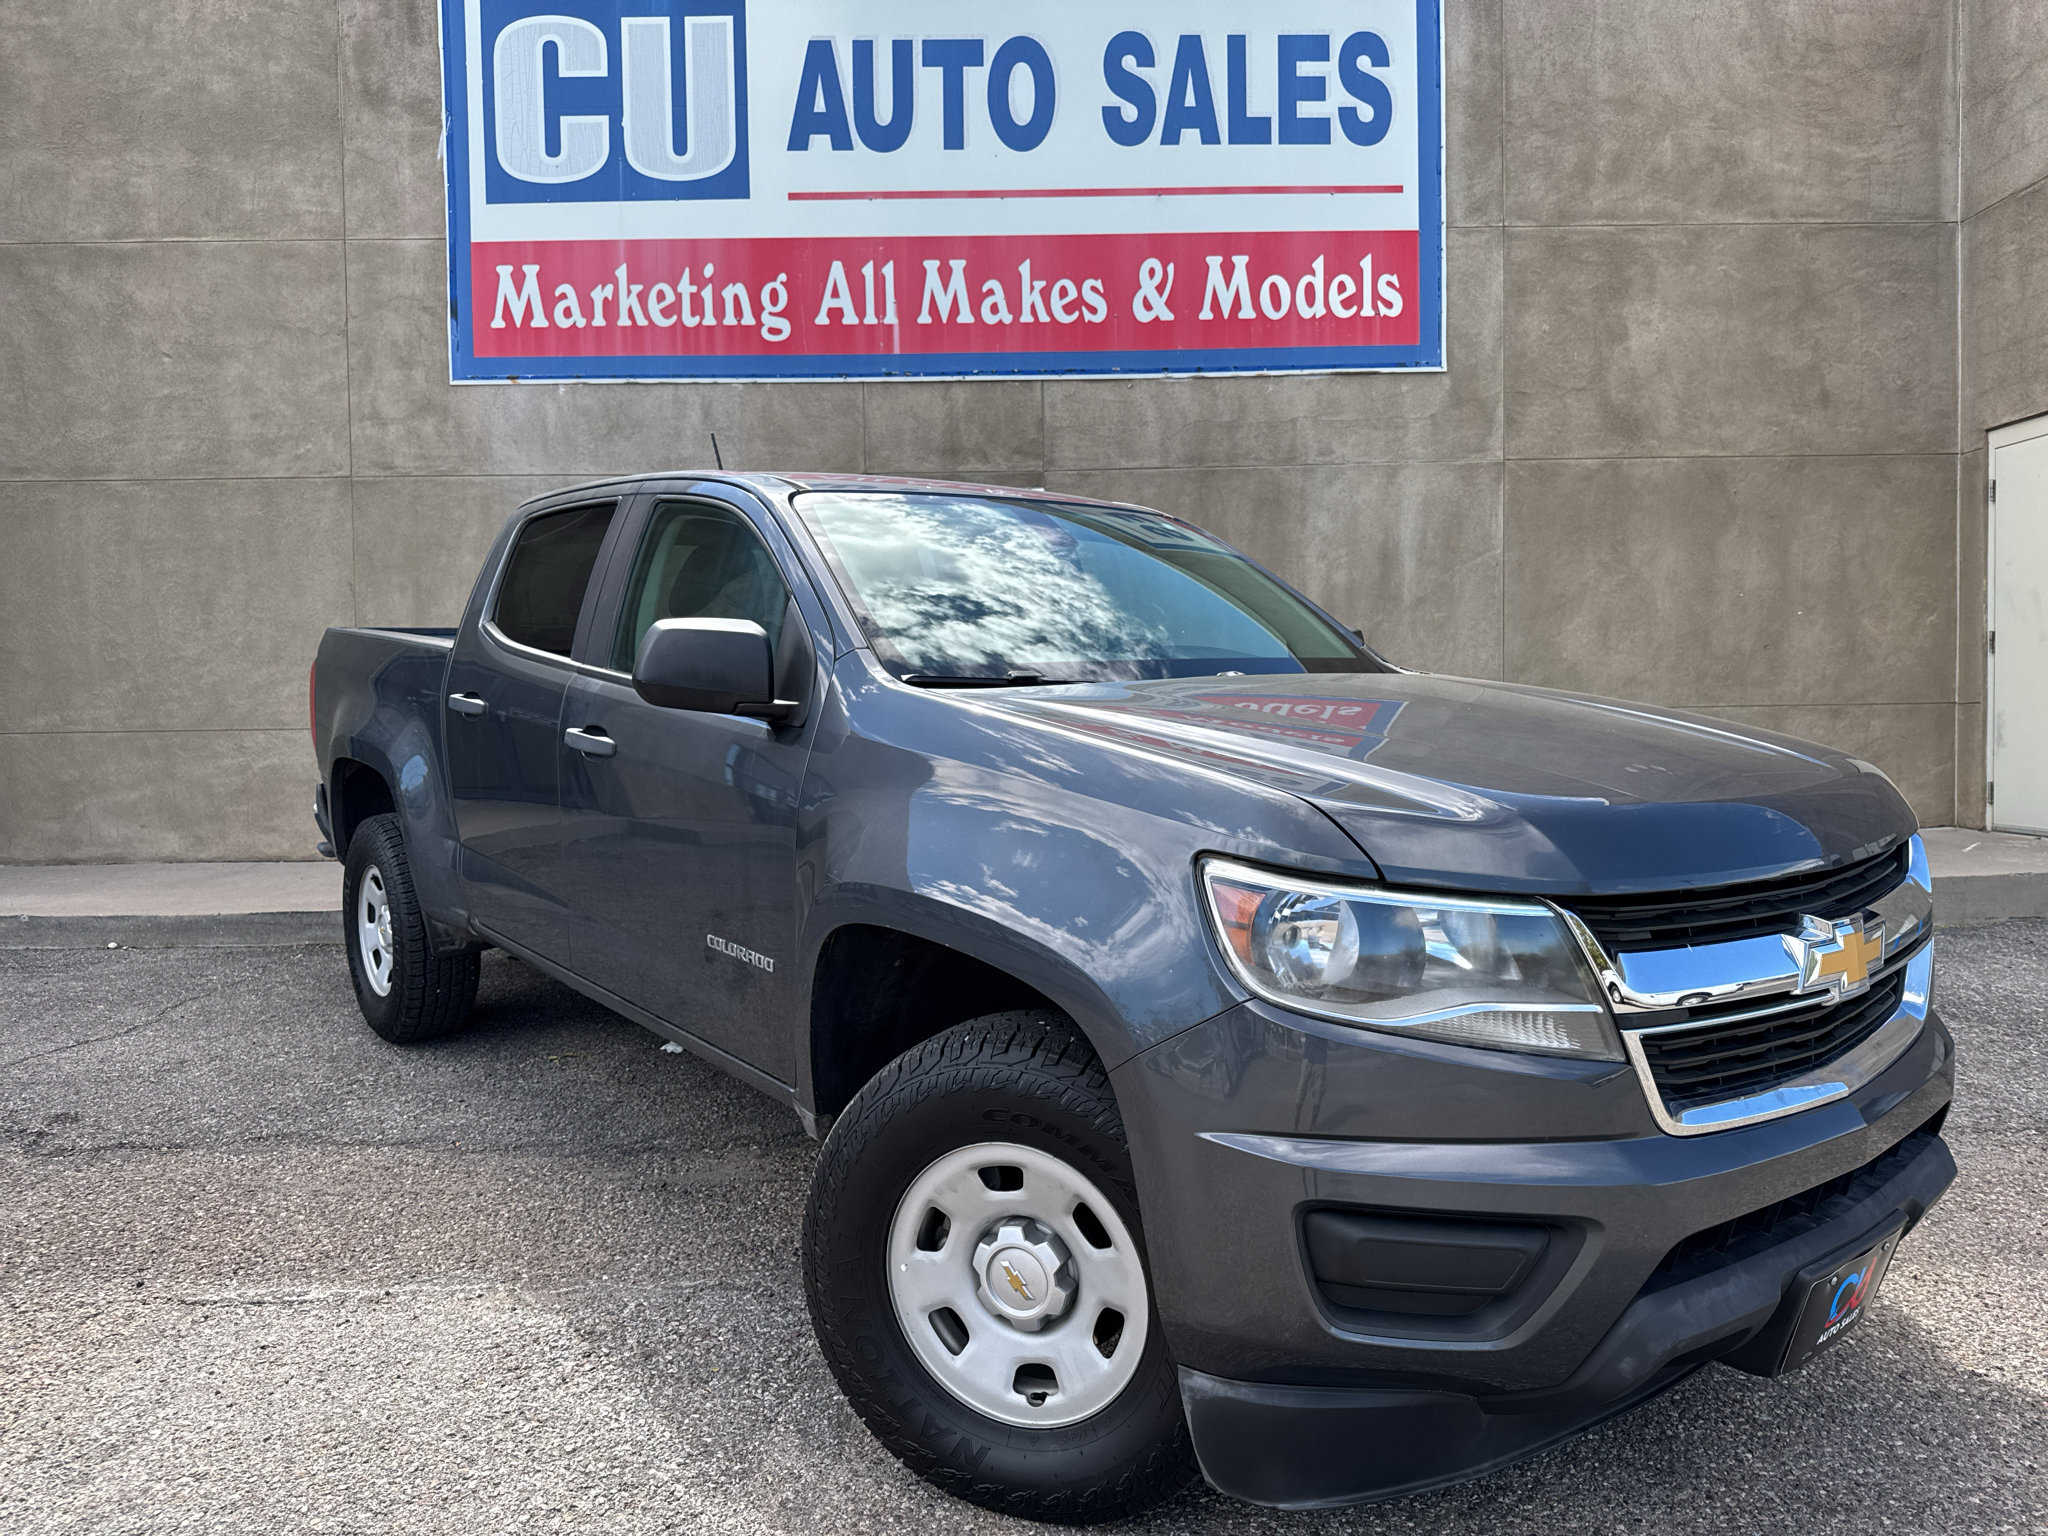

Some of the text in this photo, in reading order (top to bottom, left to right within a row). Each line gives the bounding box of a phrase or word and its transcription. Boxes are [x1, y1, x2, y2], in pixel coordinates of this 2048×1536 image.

[492, 13, 737, 185] CU
[786, 30, 1393, 153] AUTO SALES
[489, 252, 1404, 343] Marketing All Makes & Models
[706, 933, 774, 973] COLORADO
[1815, 1322, 1841, 1346] AUTO
